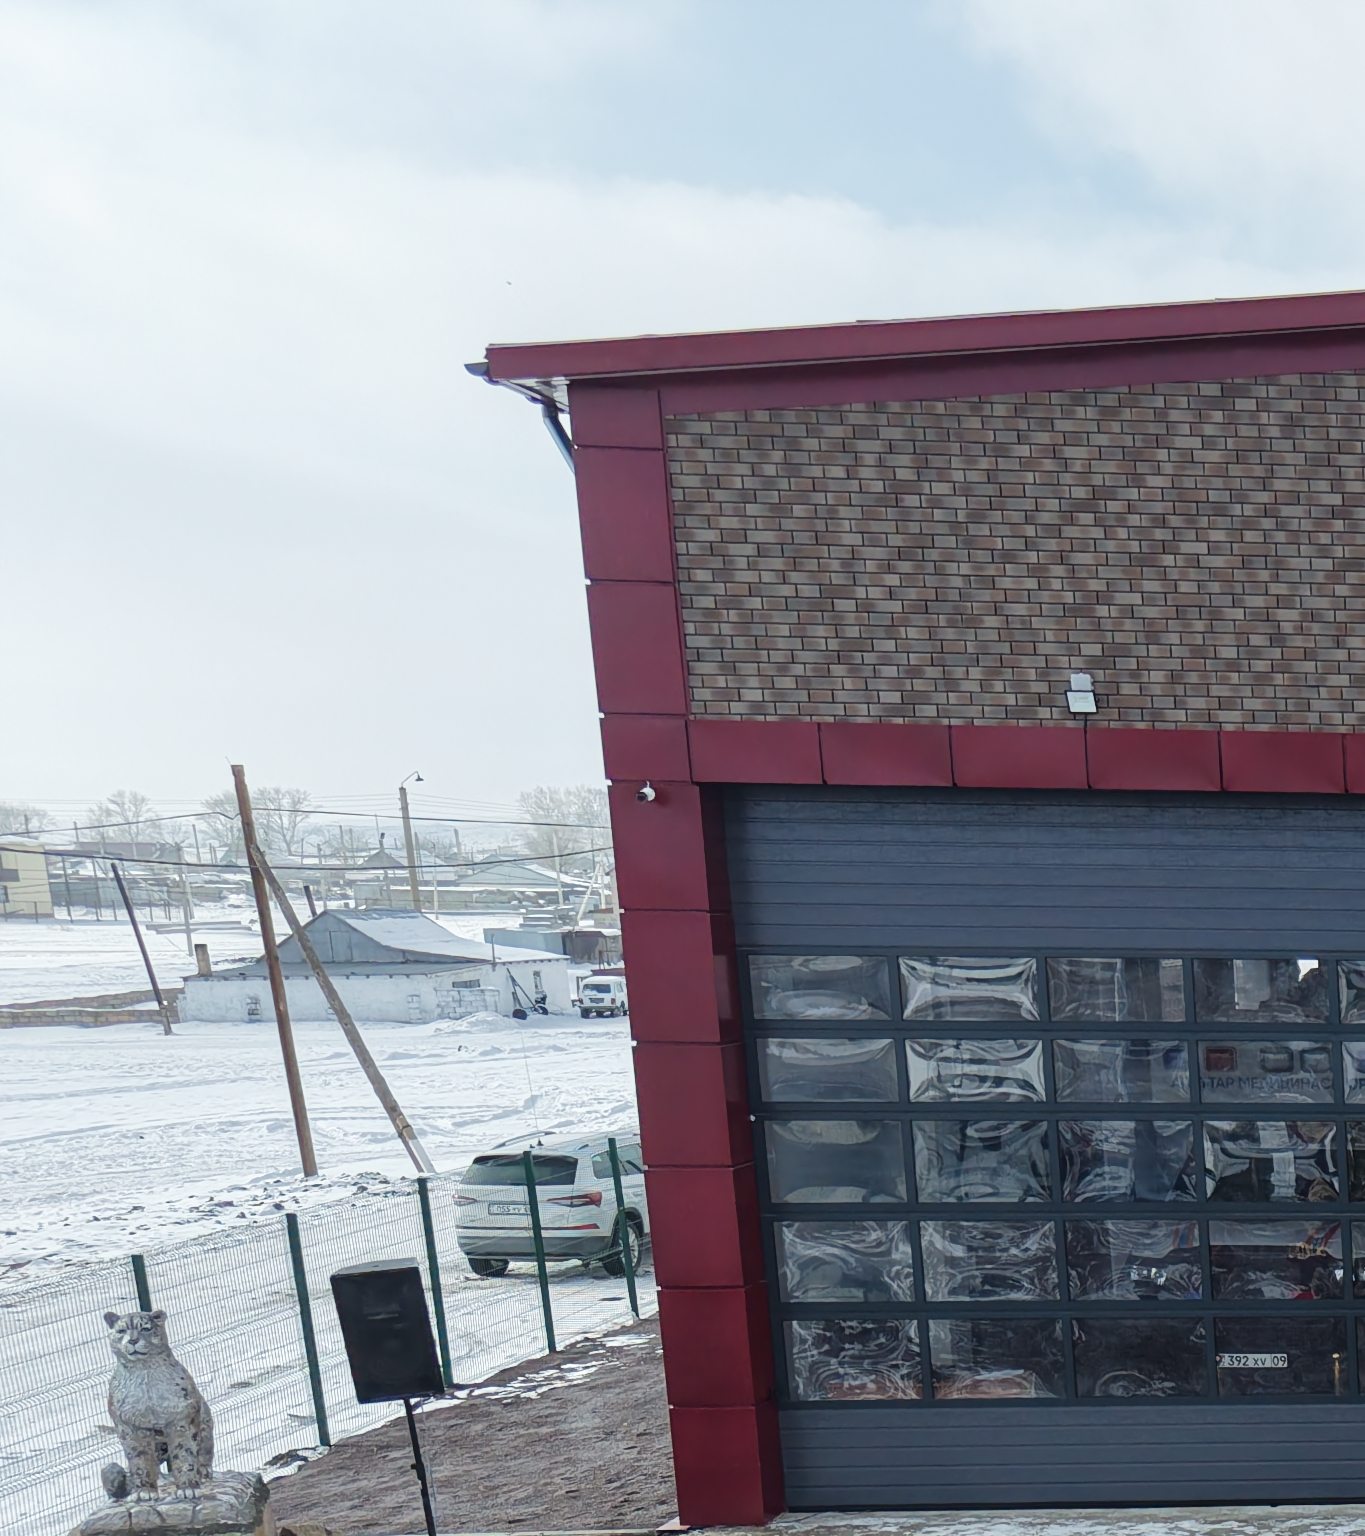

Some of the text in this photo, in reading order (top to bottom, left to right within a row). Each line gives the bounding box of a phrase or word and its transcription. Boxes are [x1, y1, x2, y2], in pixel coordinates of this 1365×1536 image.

[1239, 1077, 1334, 1091] МЕДИЦИНАС
[1227, 1355, 1287, 1366] 392 XV 09
